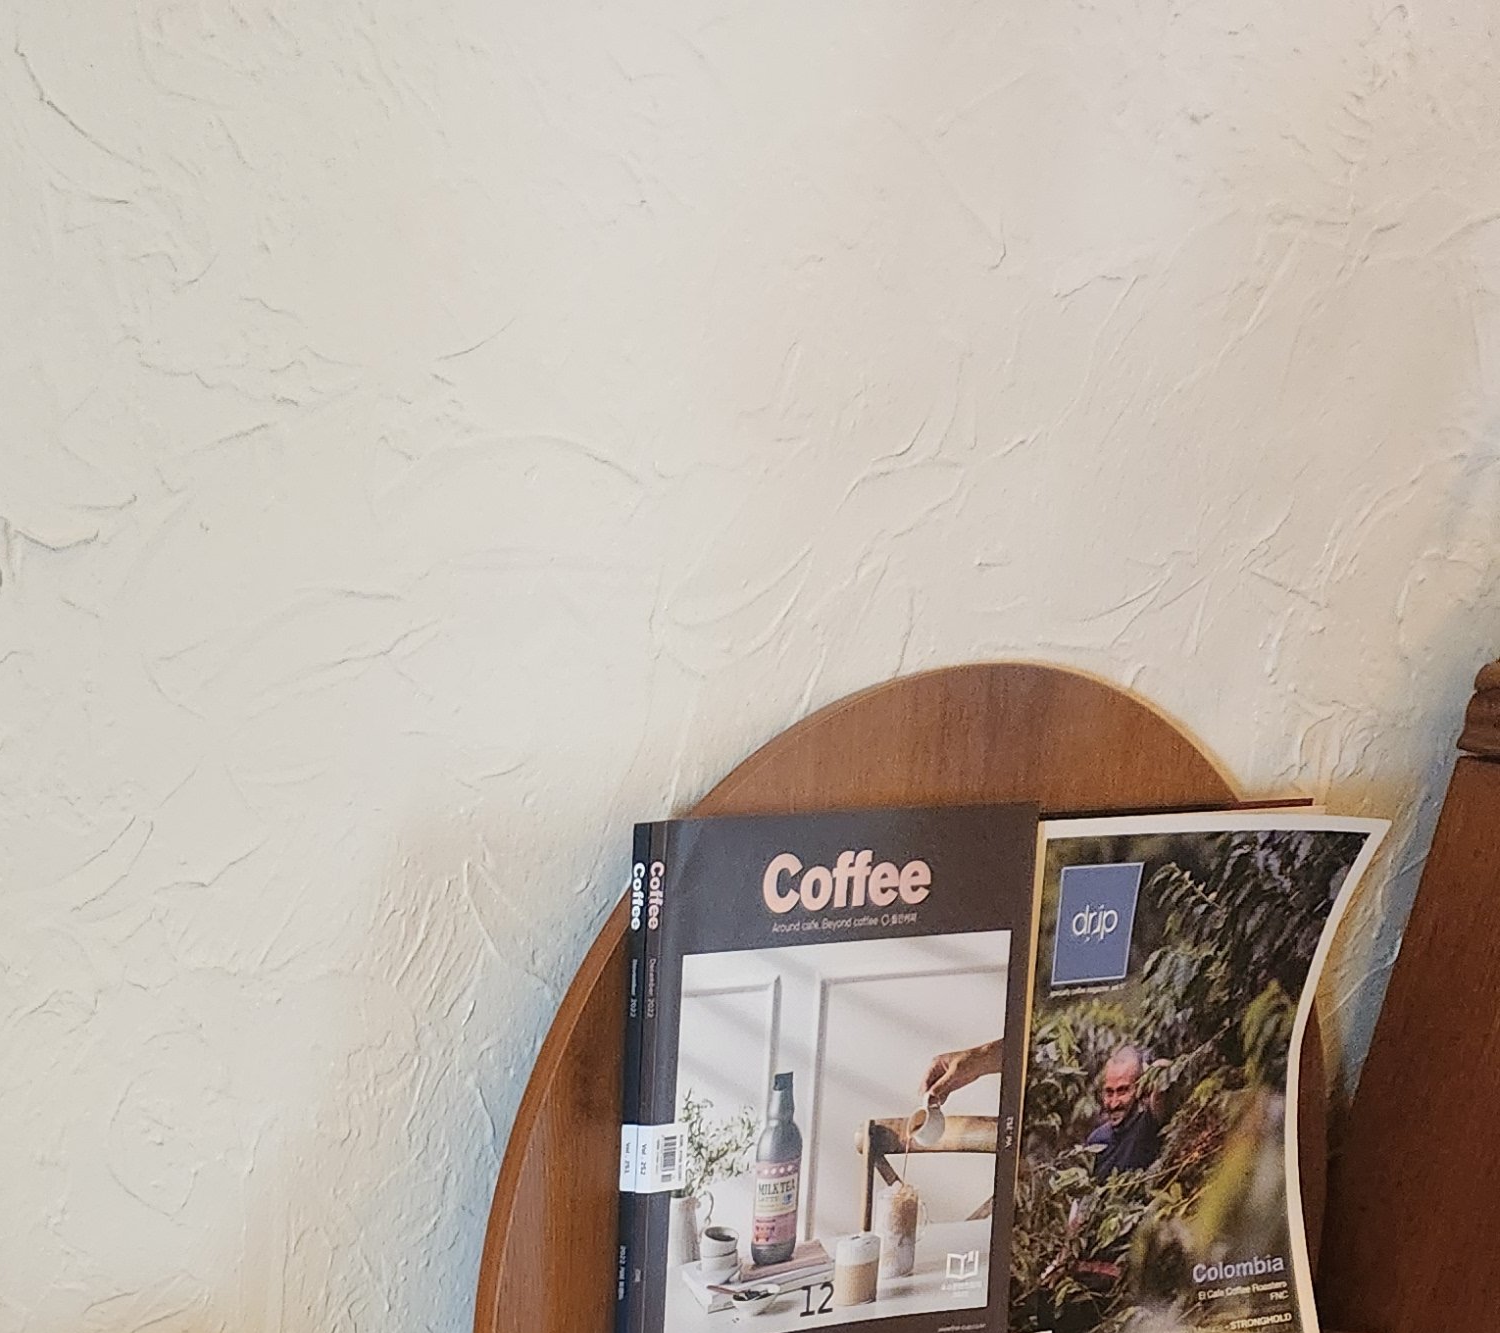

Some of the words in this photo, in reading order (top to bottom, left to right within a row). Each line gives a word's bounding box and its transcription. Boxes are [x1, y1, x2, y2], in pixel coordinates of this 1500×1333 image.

[631, 862, 646, 931] Coffee
[648, 861, 665, 931] Coffee
[763, 850, 932, 914] Coffee
[1192, 1254, 1285, 1283] Colombia
[800, 1281, 835, 1318] 12
[1252, 1280, 1288, 1293] Roasters
[1269, 1291, 1290, 1301] FNC
[1230, 1312, 1293, 1330] STRONGHOLD
